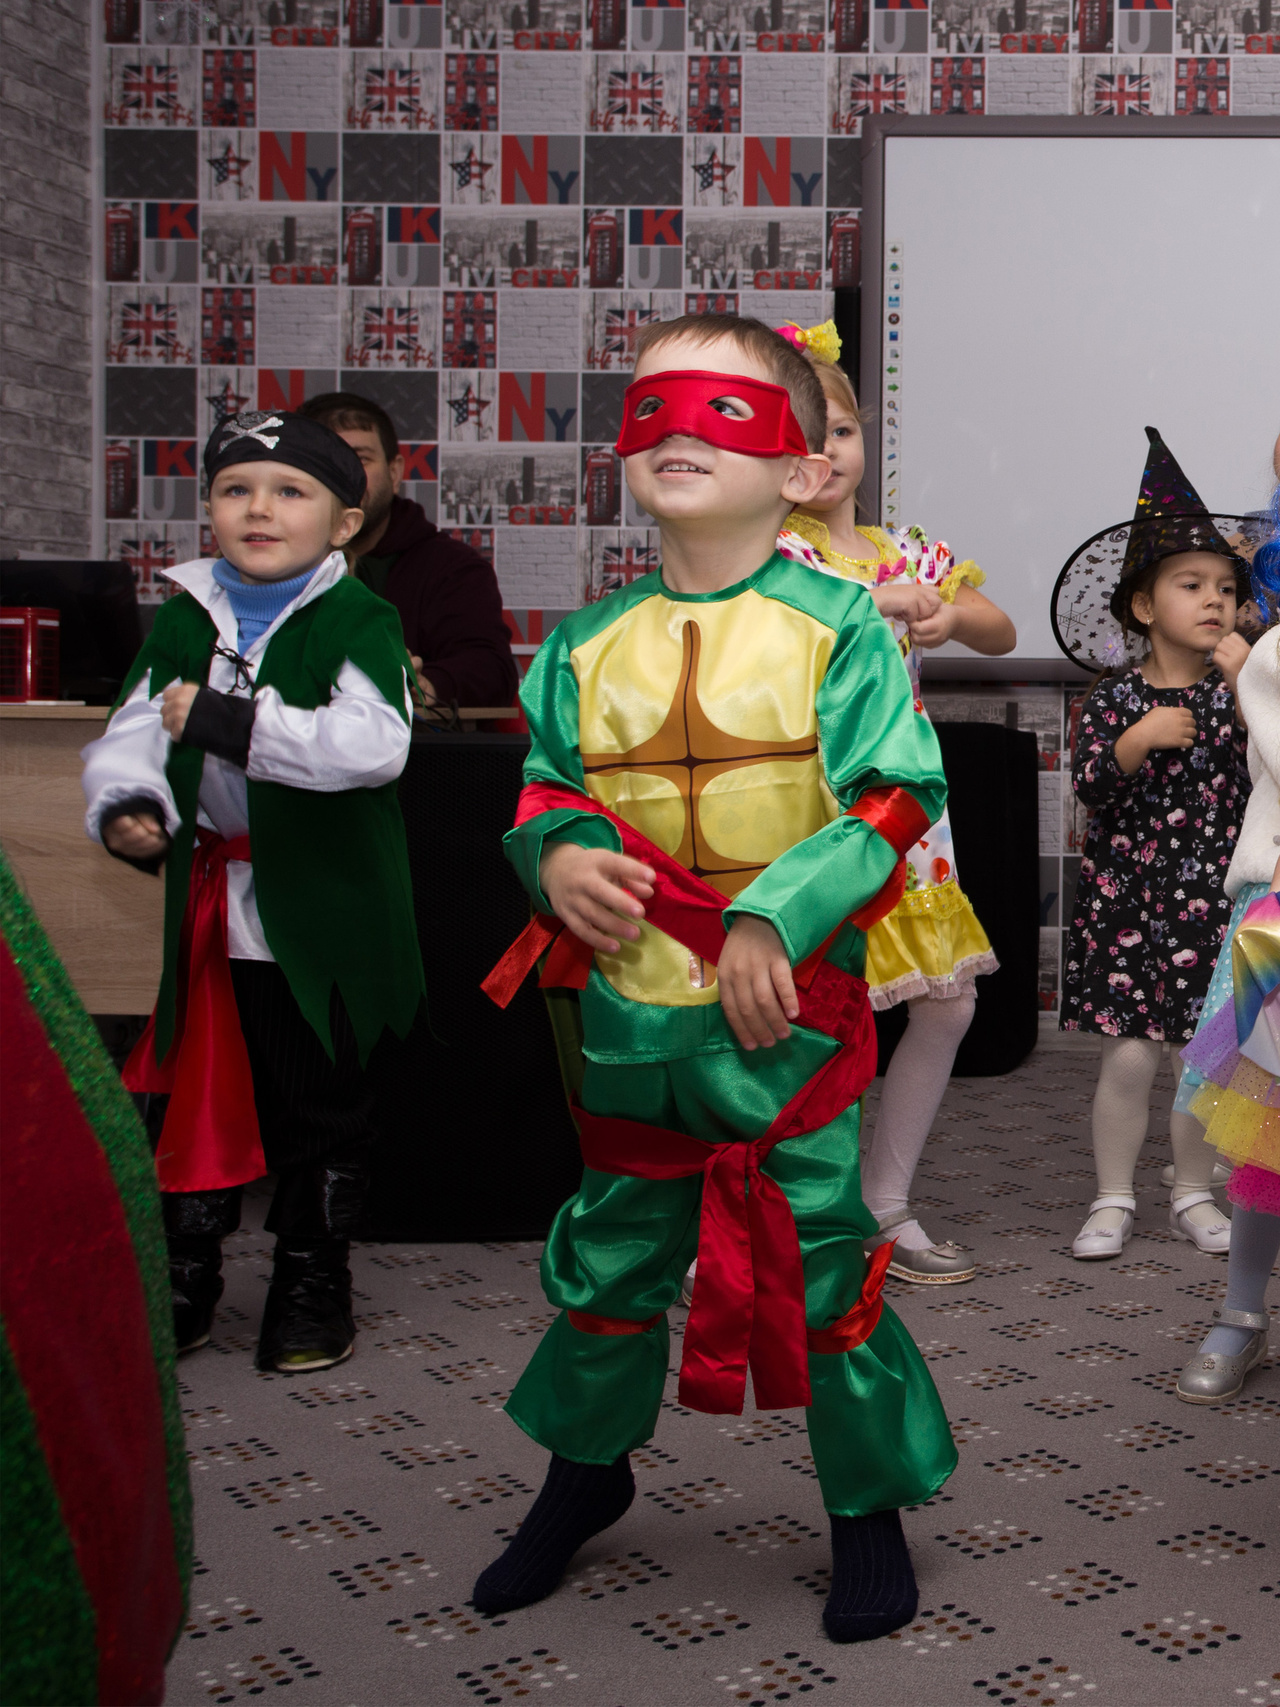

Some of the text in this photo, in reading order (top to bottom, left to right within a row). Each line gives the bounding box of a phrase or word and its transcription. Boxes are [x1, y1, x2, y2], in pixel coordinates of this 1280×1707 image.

[271, 27, 339, 46] CITY
[514, 31, 582, 50] CITY
[757, 33, 825, 52] CITY
[1000, 34, 1068, 53] CITY
[270, 265, 338, 284] CITY
[512, 269, 580, 288] CITY
[754, 271, 822, 290] CITY
[509, 506, 577, 525] CITY
